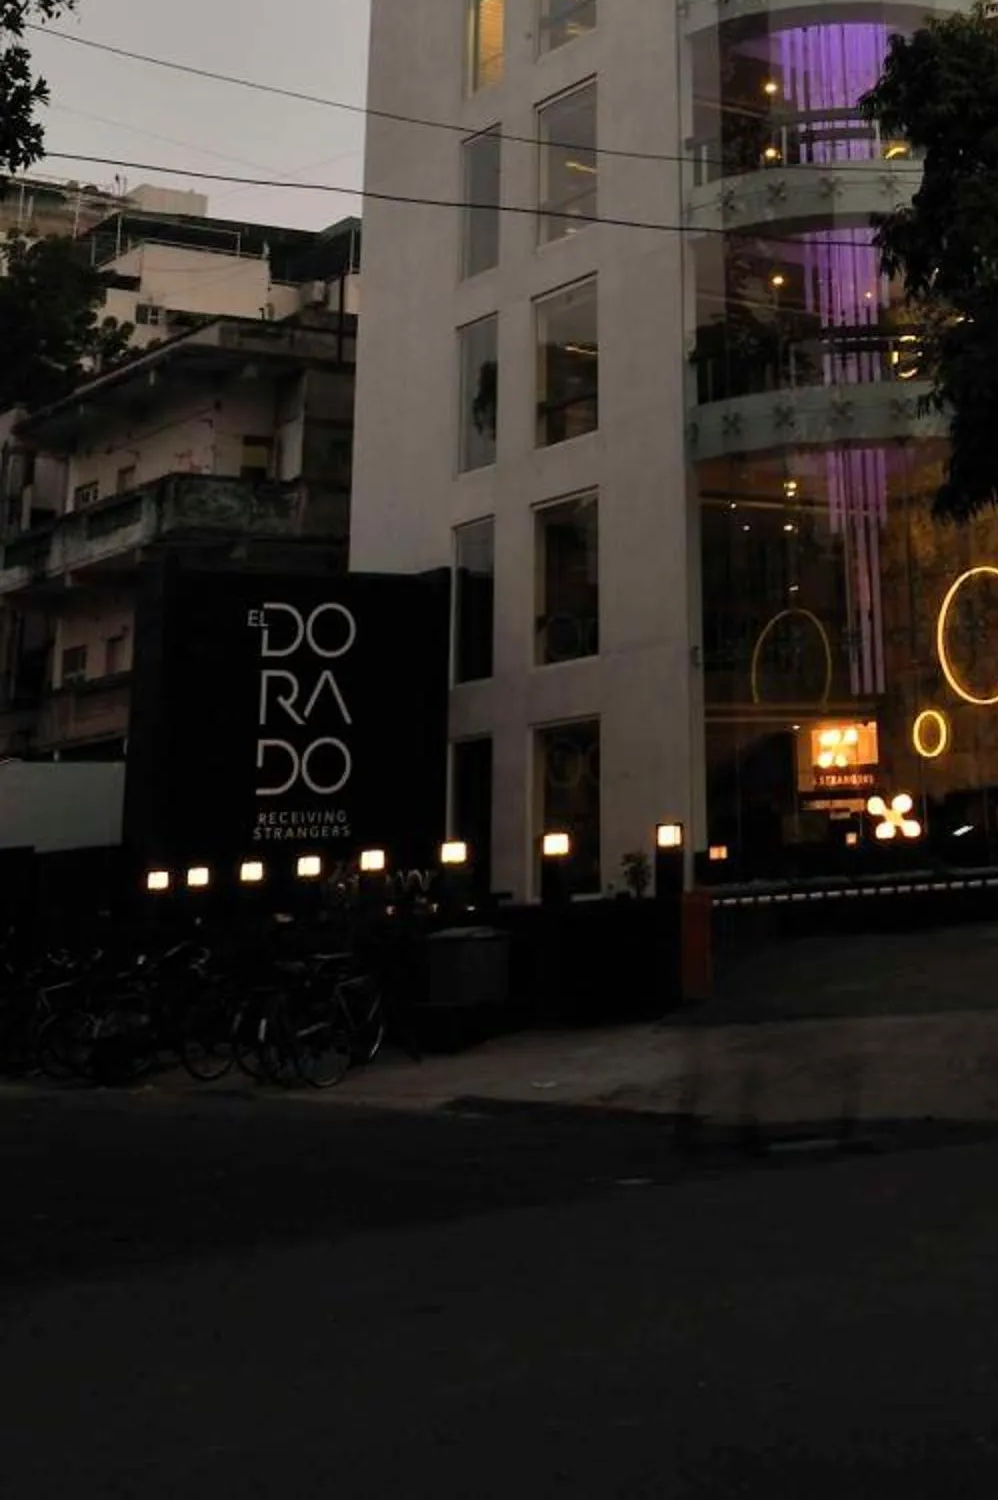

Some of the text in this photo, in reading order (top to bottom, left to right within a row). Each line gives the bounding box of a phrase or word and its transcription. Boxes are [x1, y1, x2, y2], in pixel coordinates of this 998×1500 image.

[247, 601, 357, 658] EL DO
[259, 668, 353, 725] RA
[255, 737, 352, 796] DO
[252, 824, 352, 841] STRANGERS
[257, 809, 347, 826] RECEIVING
